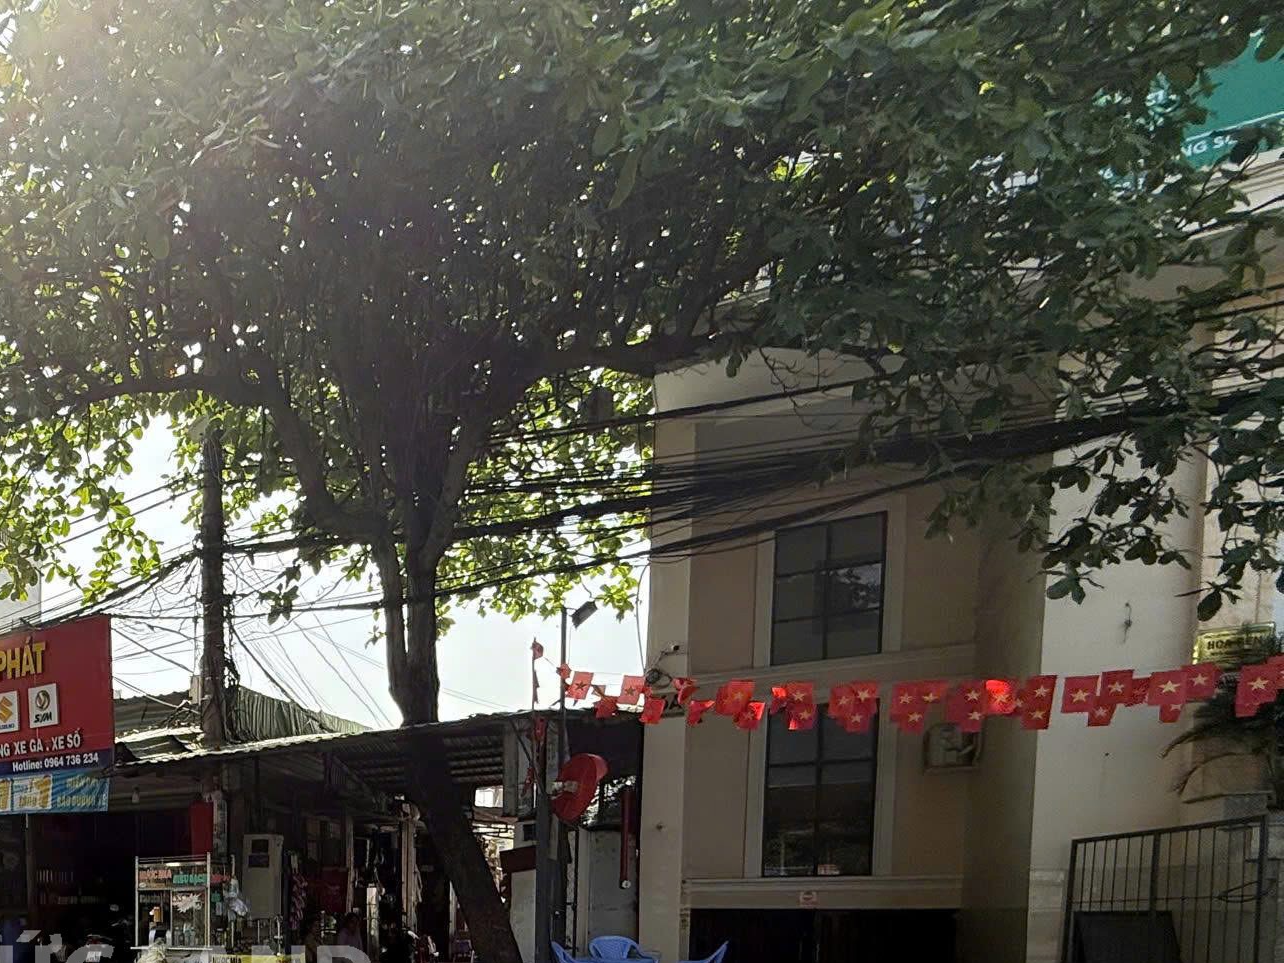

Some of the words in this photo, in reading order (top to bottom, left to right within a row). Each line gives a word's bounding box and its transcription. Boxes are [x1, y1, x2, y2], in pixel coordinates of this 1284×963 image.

[13, 740, 27, 756] XE
[51, 736, 65, 751] XE
[66, 728, 81, 748] SỐ
[12, 760, 43, 773] Hotline:
[44, 756, 64, 768] 0964
[65, 755, 81, 765] 736
[83, 752, 99, 764] 234
